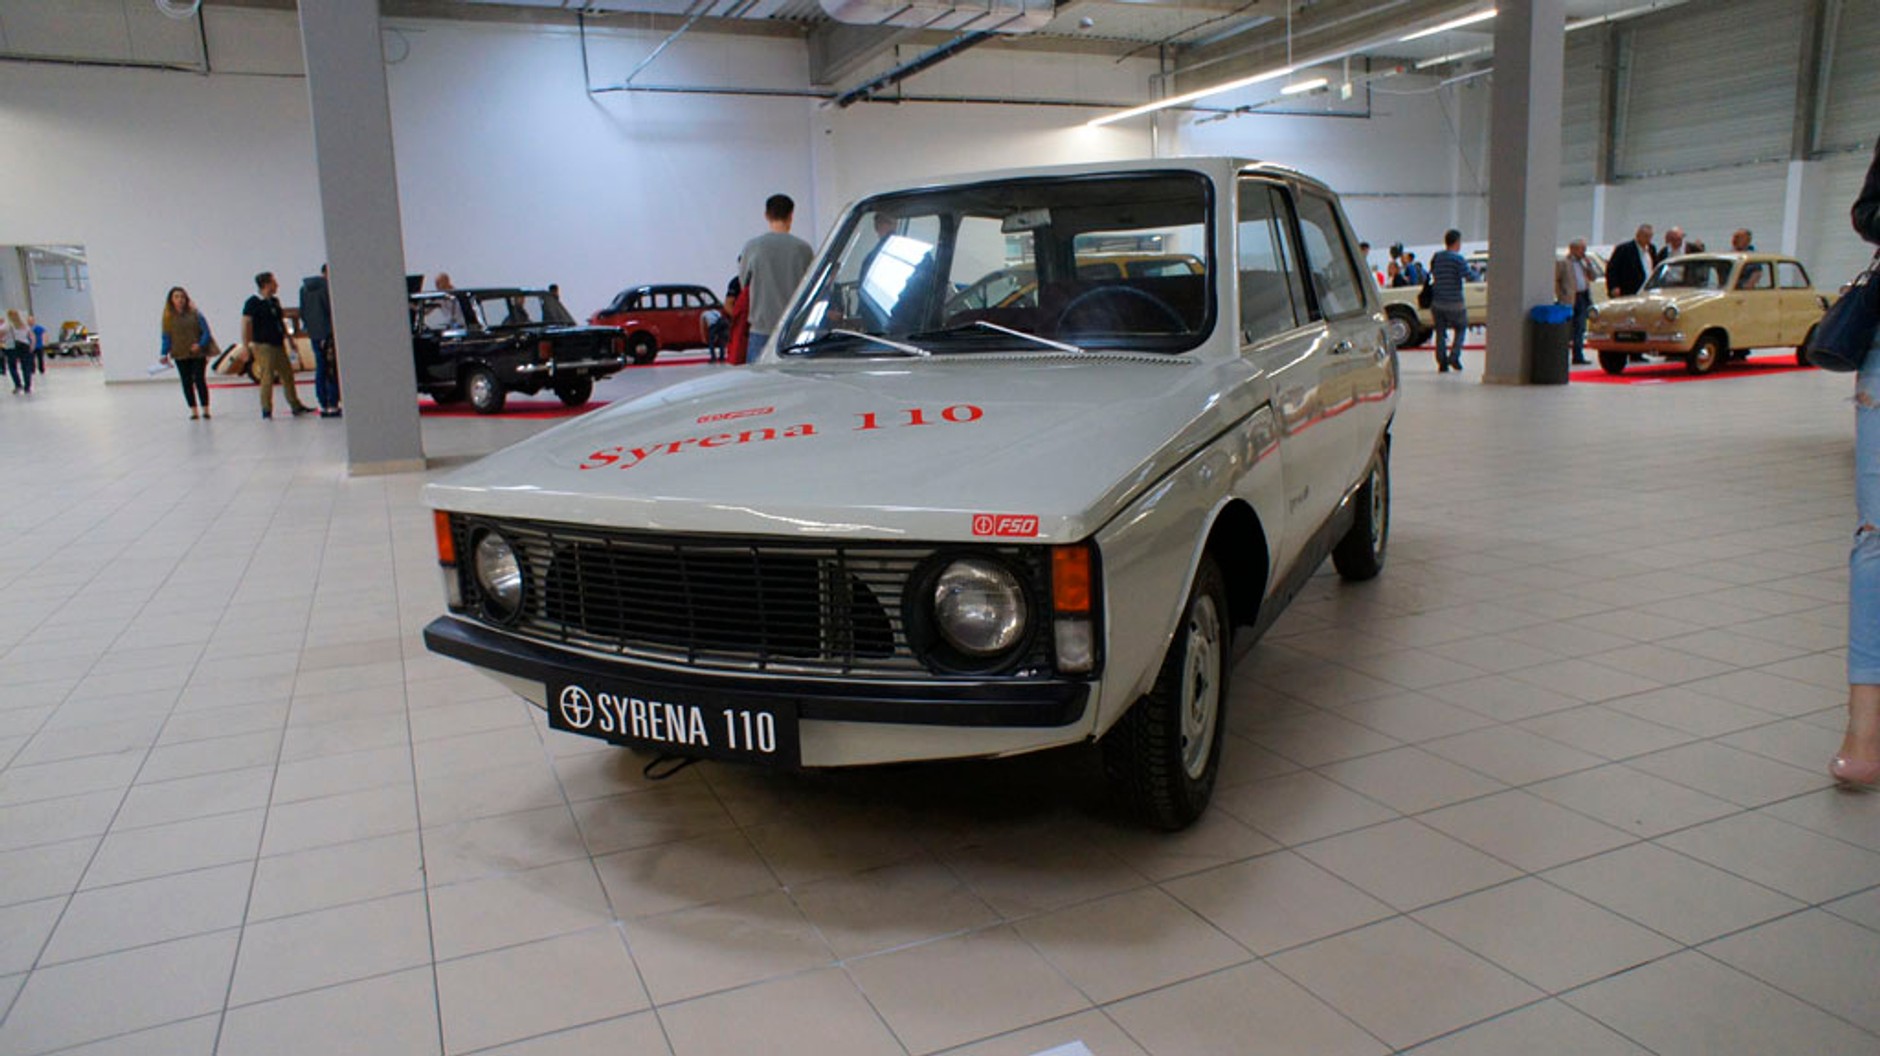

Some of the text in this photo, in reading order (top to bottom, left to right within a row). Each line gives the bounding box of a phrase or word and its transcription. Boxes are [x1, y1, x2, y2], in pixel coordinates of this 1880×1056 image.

[579, 404, 985, 471] Syrena 110
[997, 518, 1037, 534] FSO
[597, 692, 776, 753] SYRENA 110
